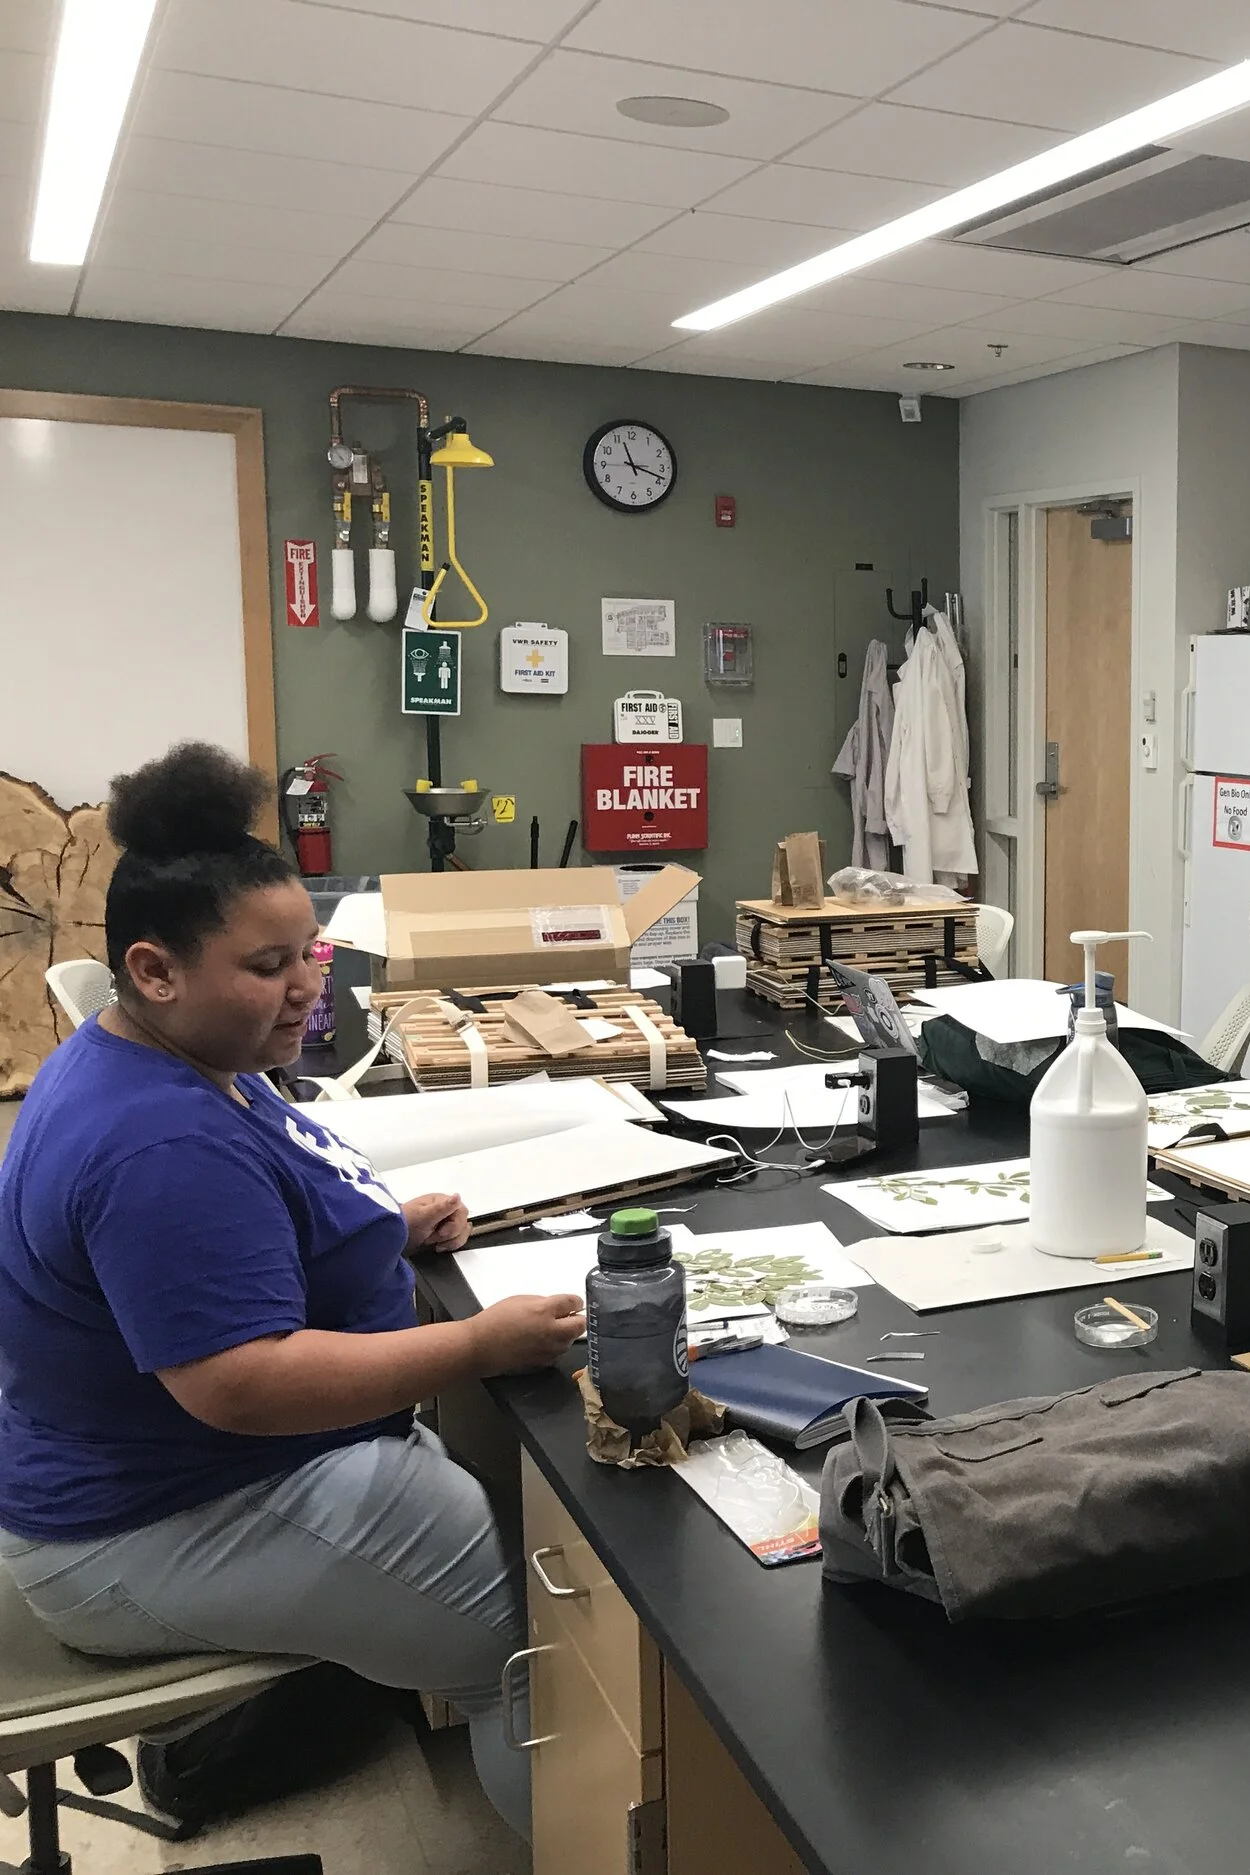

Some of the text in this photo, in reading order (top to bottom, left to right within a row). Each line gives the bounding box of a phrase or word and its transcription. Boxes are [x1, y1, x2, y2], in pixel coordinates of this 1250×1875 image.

[613, 434, 620, 444] 11
[627, 431, 637, 440] 12
[602, 445, 612, 455] 10
[656, 448, 662, 458] 2
[600, 460, 607, 469] 9
[659, 464, 665, 473] 3
[604, 474, 611, 483] 8
[655, 477, 662, 486] 4
[616, 485, 622, 495] 7
[646, 487, 652, 497] 5
[630, 491, 637, 500] 6
[420, 484, 430, 562] SPEAKMAN
[290, 548, 311, 560] FIRE
[410, 697, 452, 705] SPEAKMAN
[621, 703, 658, 713] FIRST AID
[667, 703, 678, 723] FIRST
[635, 715, 656, 725] XXV
[623, 765, 674, 787] FIRE
[1219, 787, 1230, 797] Gen
[1231, 788, 1240, 798] Bio
[596, 788, 701, 810] BLANKET
[1224, 805, 1248, 816] No Food
